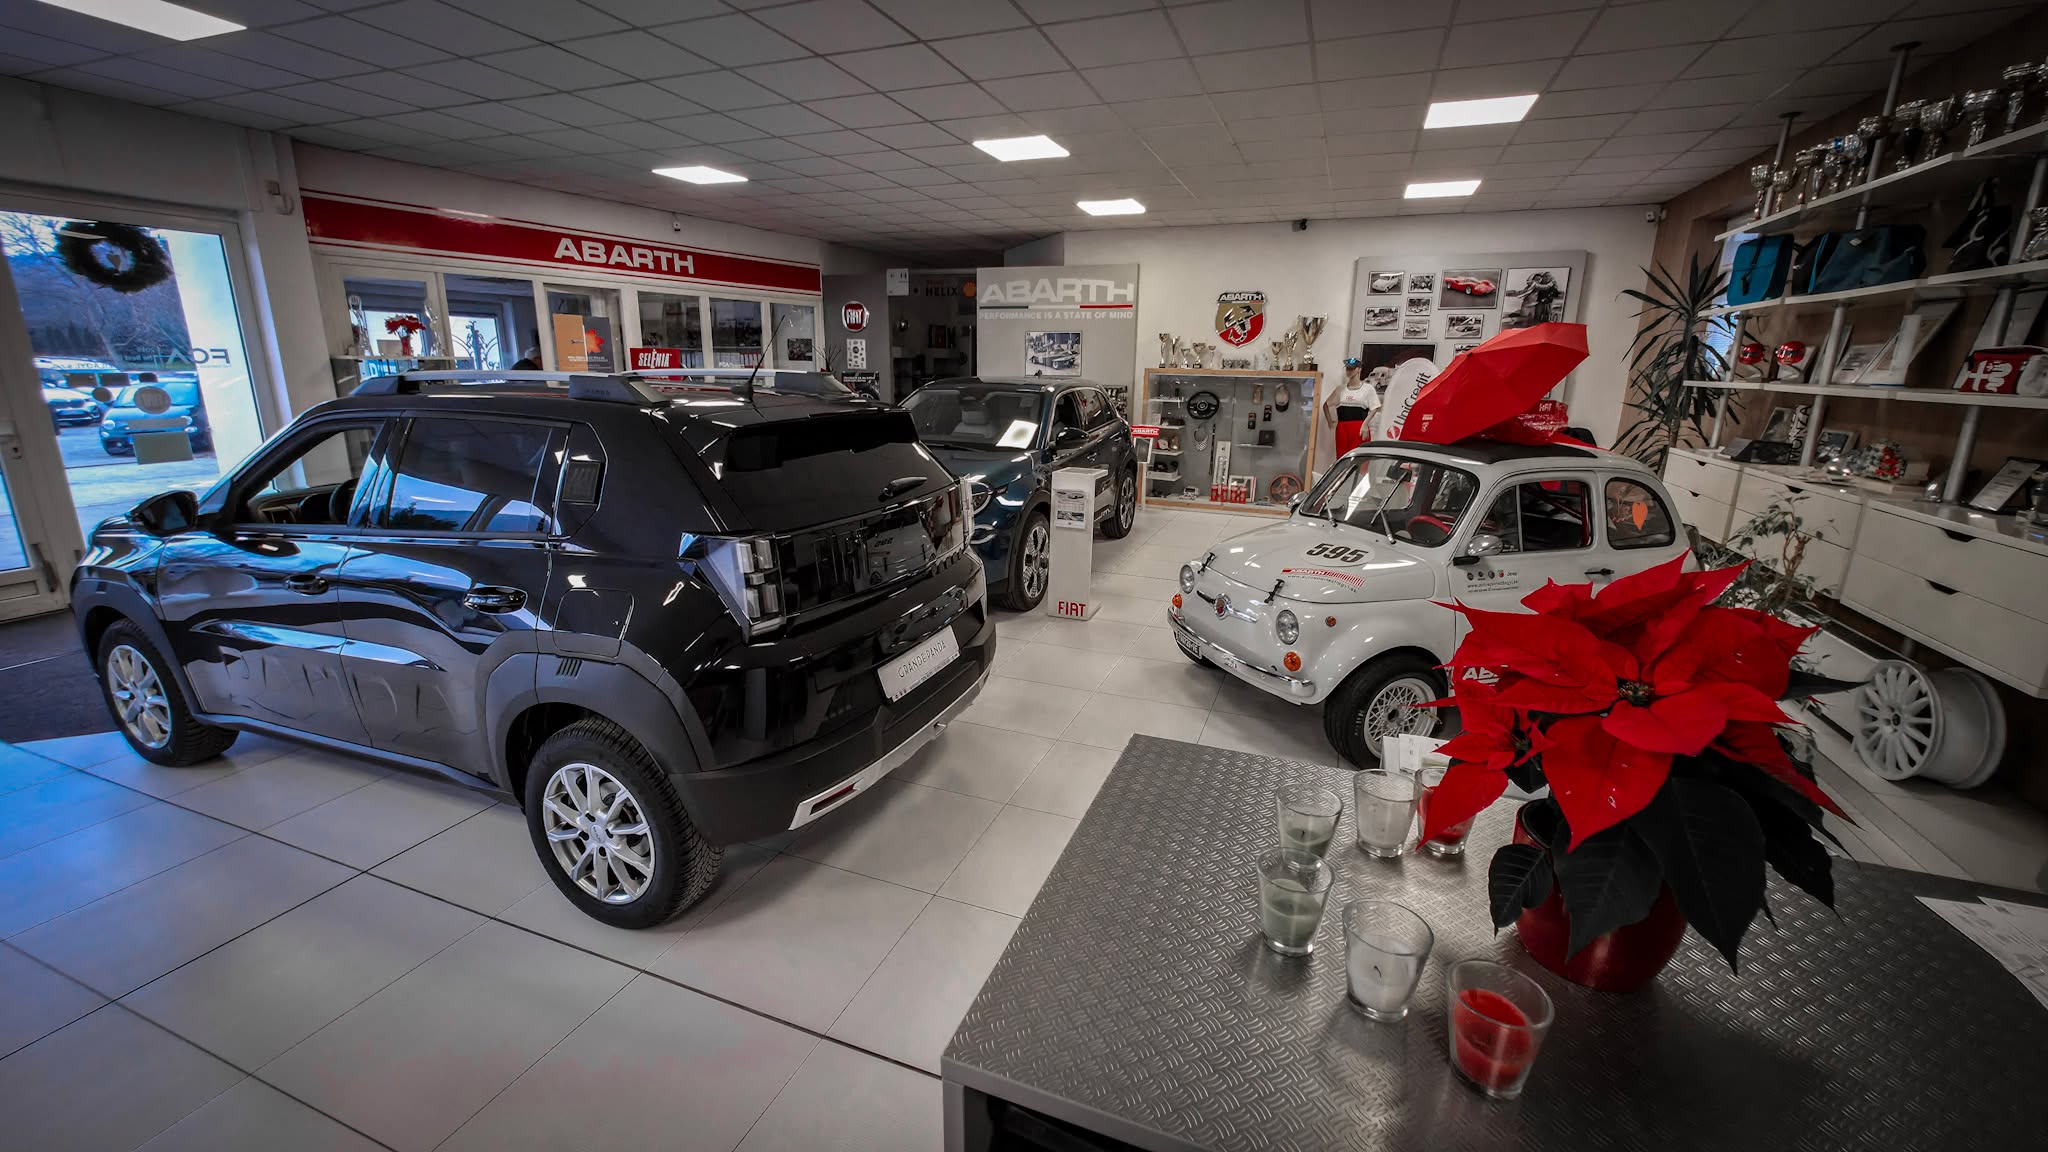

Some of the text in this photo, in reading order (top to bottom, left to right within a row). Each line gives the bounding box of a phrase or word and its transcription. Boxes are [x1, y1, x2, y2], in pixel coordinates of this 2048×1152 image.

[554, 237, 695, 274] ABARTH
[925, 287, 958, 297] HELIX
[980, 278, 1135, 303] ABARTH
[1220, 293, 1262, 301] ABARTH
[979, 311, 1133, 320] PERFORMANCE IS A STATE OF MIND
[1394, 372, 1432, 426] UniCredit
[1306, 543, 1369, 563] 595
[1058, 600, 1086, 617] FIAT
[897, 653, 927, 678] GRANDE
[926, 640, 947, 659] PANDA
